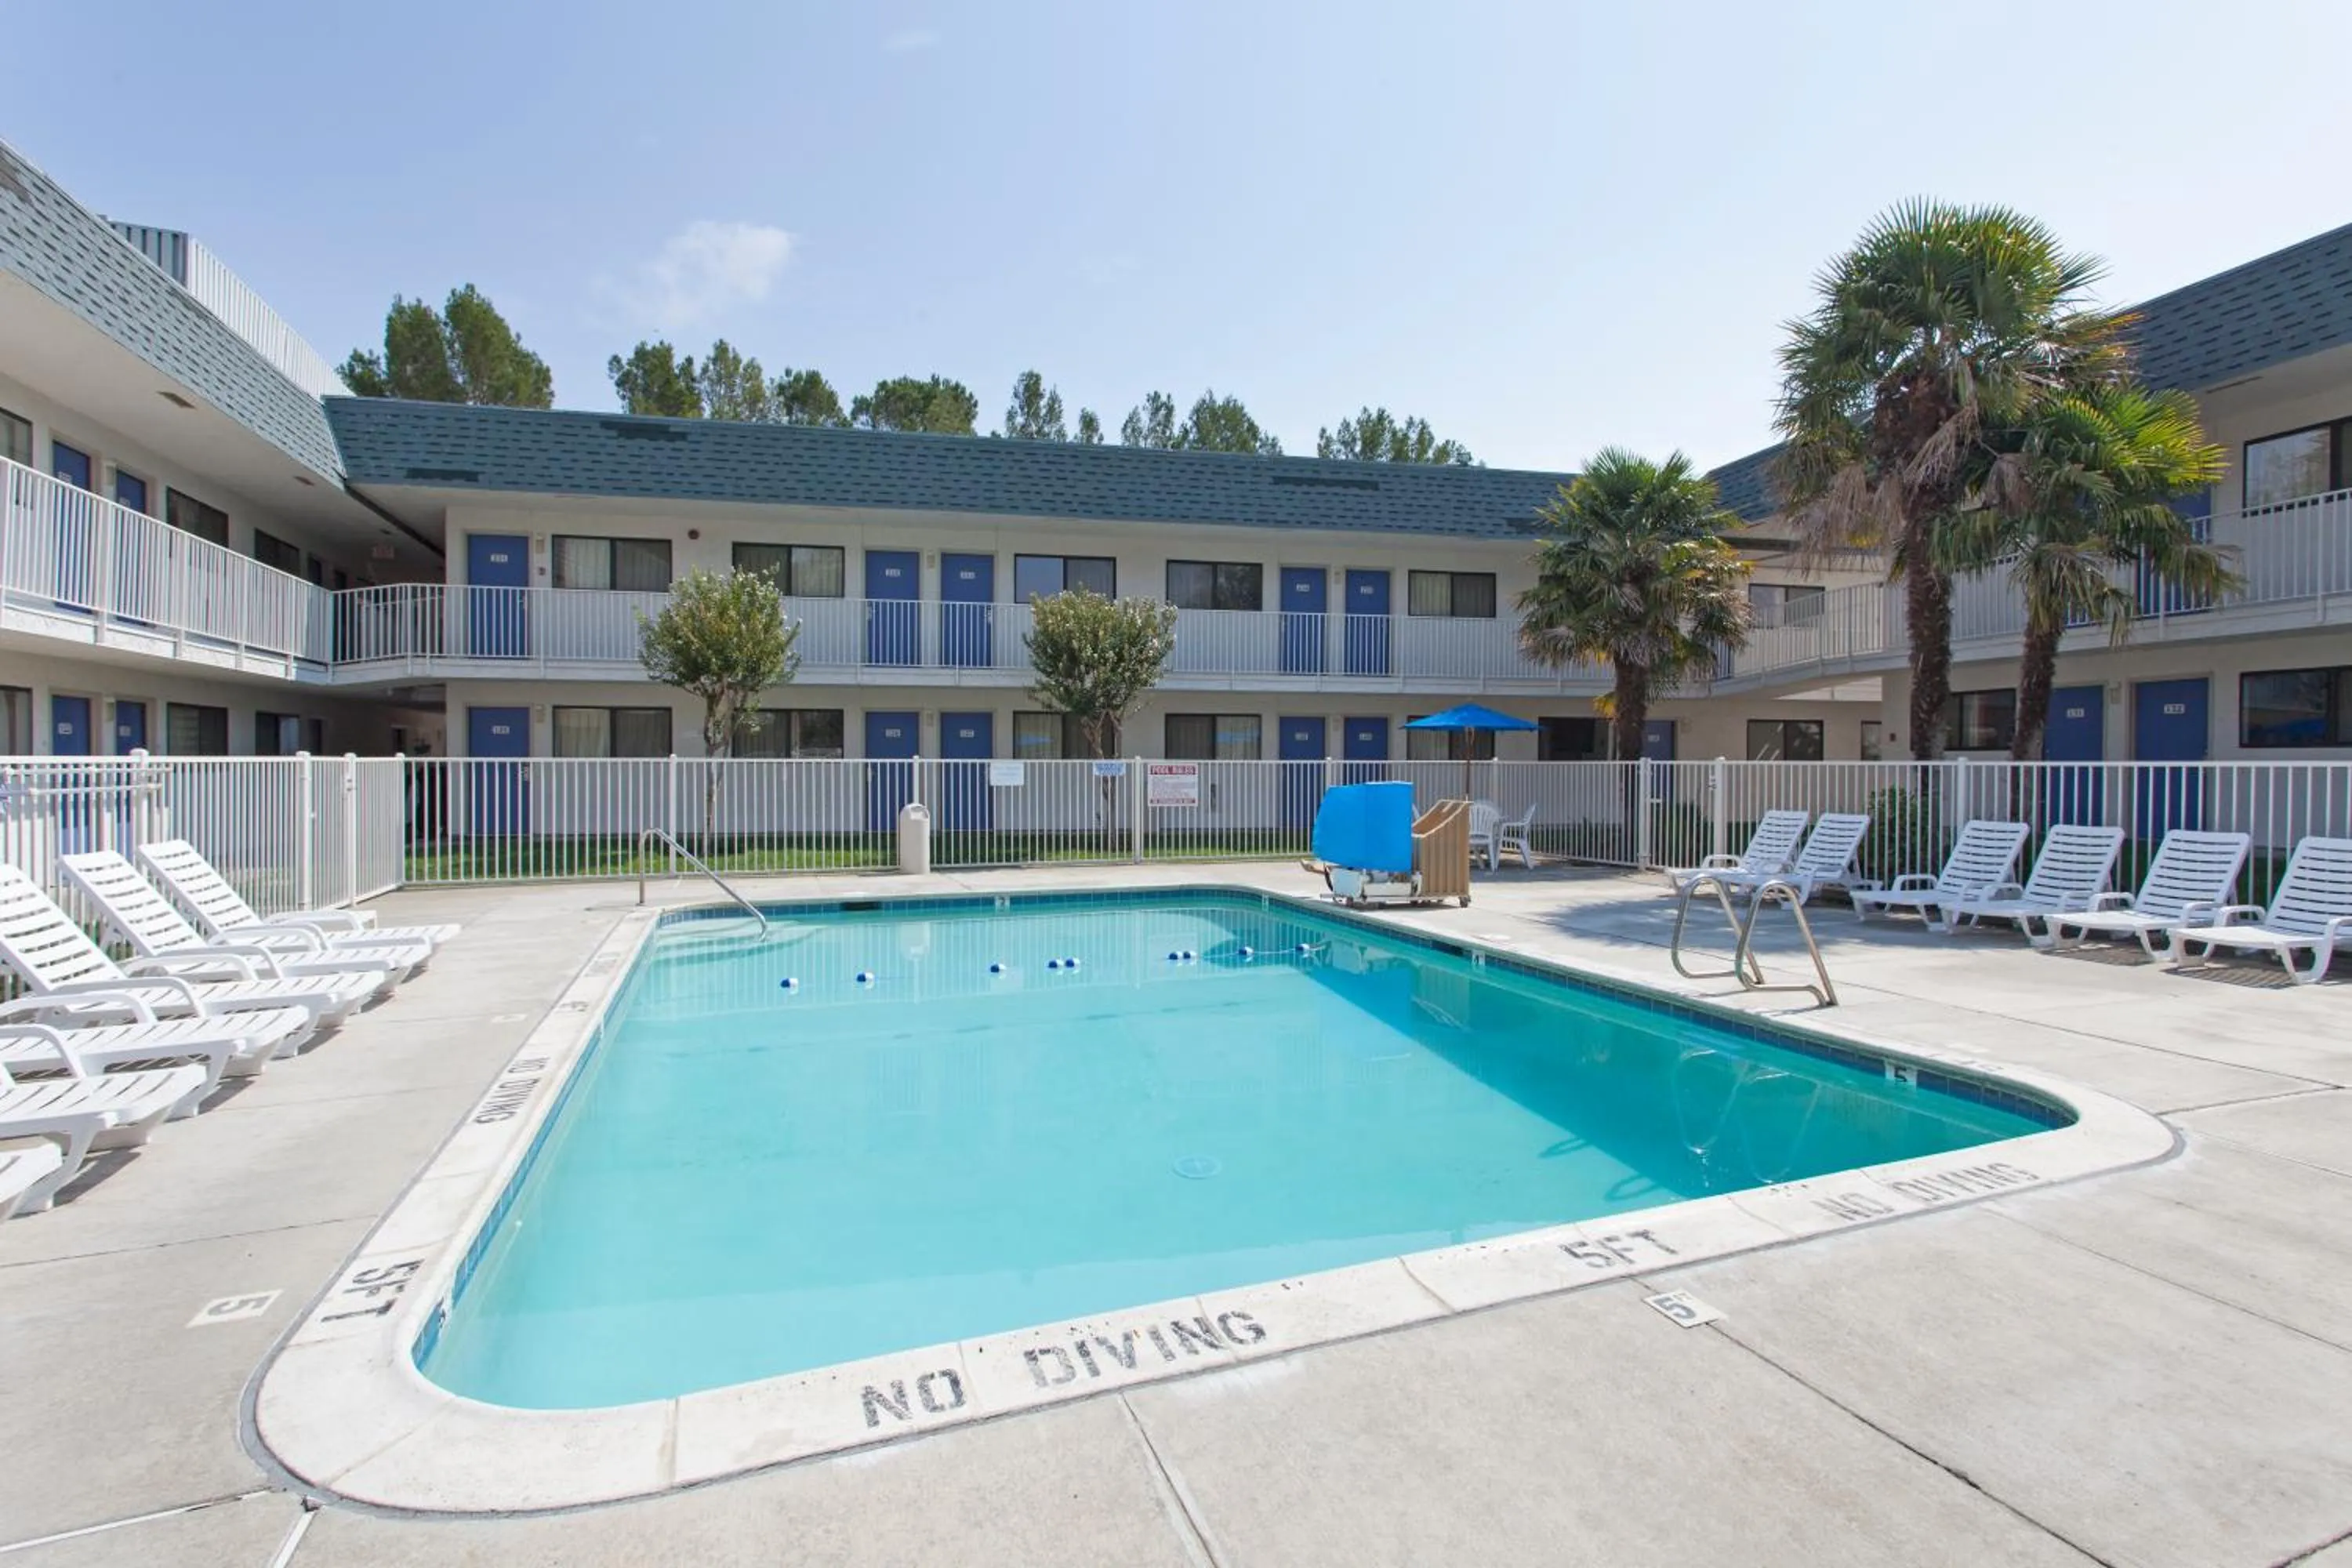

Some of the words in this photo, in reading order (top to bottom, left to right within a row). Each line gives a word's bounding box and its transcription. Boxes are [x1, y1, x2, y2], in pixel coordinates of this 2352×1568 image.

[1893, 1065, 1907, 1085] 5
[475, 1077, 541, 1123] DIVING
[1810, 1193, 1894, 1221] NO
[1888, 1163, 2039, 1201] DIVING
[1558, 1229, 1679, 1268] 5FT
[207, 1295, 270, 1316] 5
[321, 1258, 425, 1323] 5FT
[1653, 1296, 1696, 1319] 5
[861, 1367, 967, 1428] NO
[1023, 1311, 1267, 1388] DIVING
